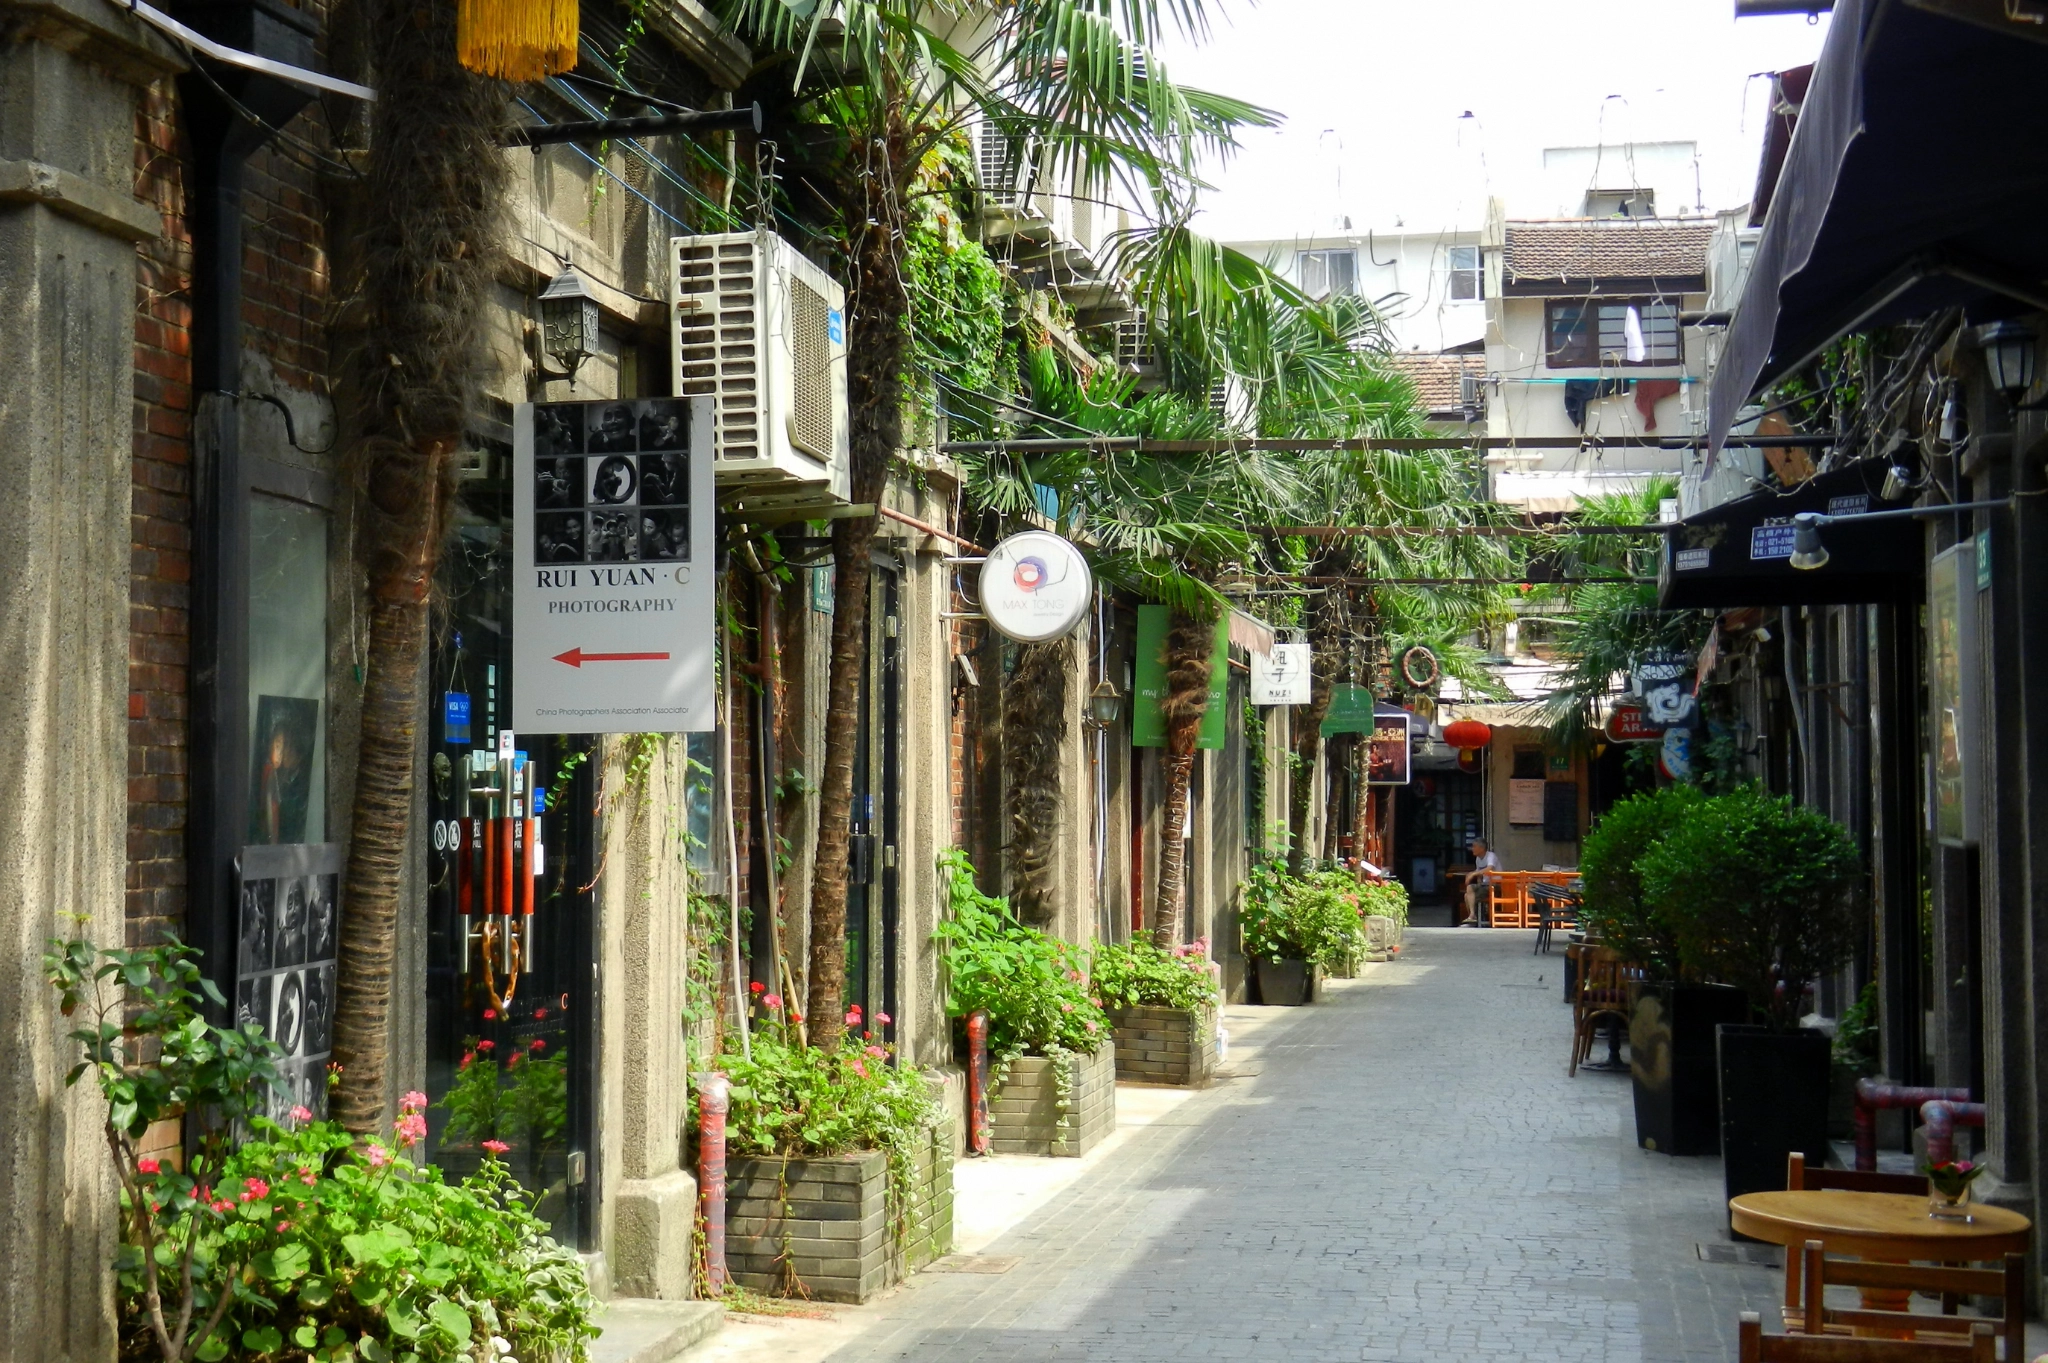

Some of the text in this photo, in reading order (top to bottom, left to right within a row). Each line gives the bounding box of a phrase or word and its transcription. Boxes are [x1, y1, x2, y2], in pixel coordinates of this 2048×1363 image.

[536, 566, 691, 588] RUI YUAN C
[548, 598, 677, 614] PHOTOGRAPHY
[1002, 598, 1065, 610] MAX TONG
[1268, 689, 1292, 697] NUZI
[535, 706, 689, 717] China Photographers Association Associator
[473, 818, 481, 838] 拉
[472, 840, 482, 849] PULL
